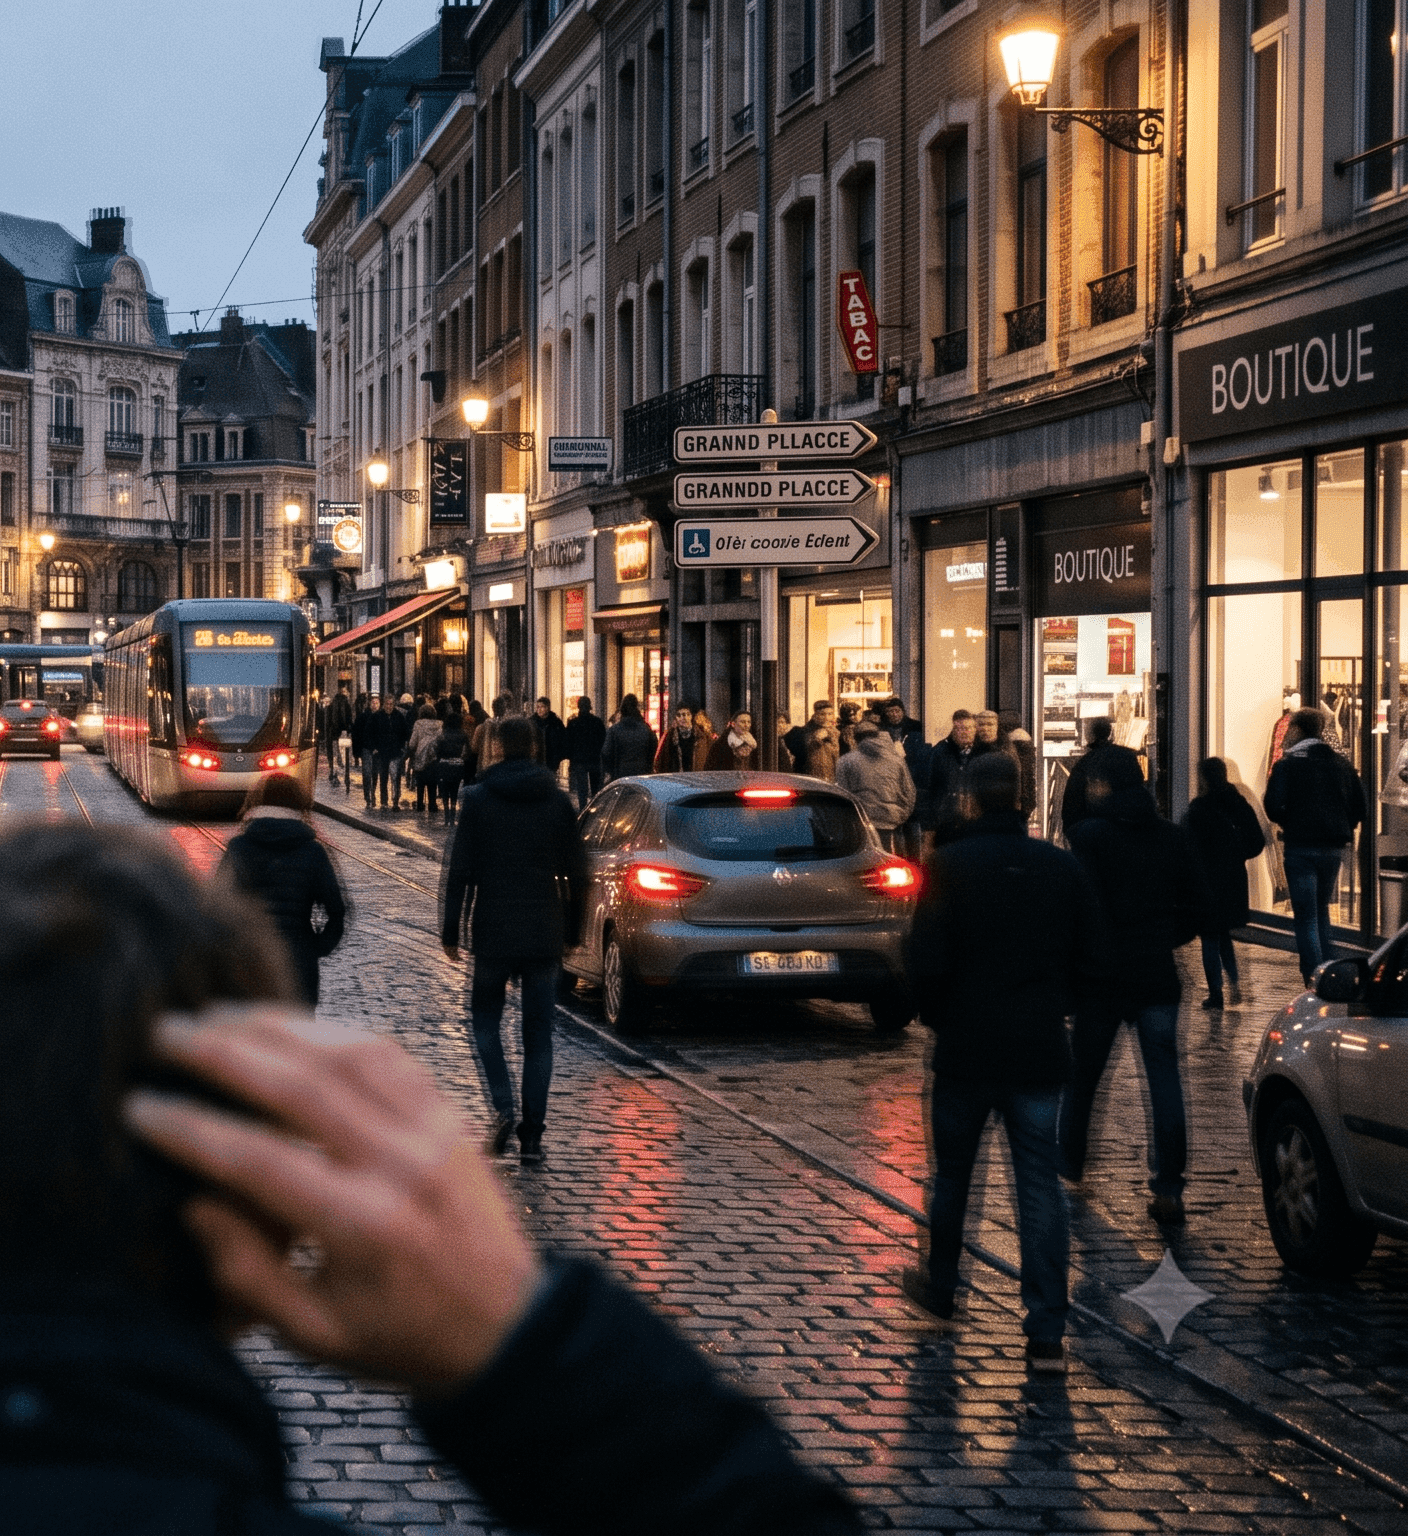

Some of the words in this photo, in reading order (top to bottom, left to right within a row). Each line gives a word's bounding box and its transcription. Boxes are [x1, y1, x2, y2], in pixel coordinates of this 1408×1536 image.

[843, 277, 873, 361] TABAC
[1212, 323, 1375, 415] BOUTIQUE
[683, 434, 760, 453] GRANND
[767, 431, 850, 450] PLLACCE
[683, 481, 772, 500] GRANNDD
[778, 479, 850, 497] PLACCE
[1054, 544, 1135, 584] BOUTIQUE
